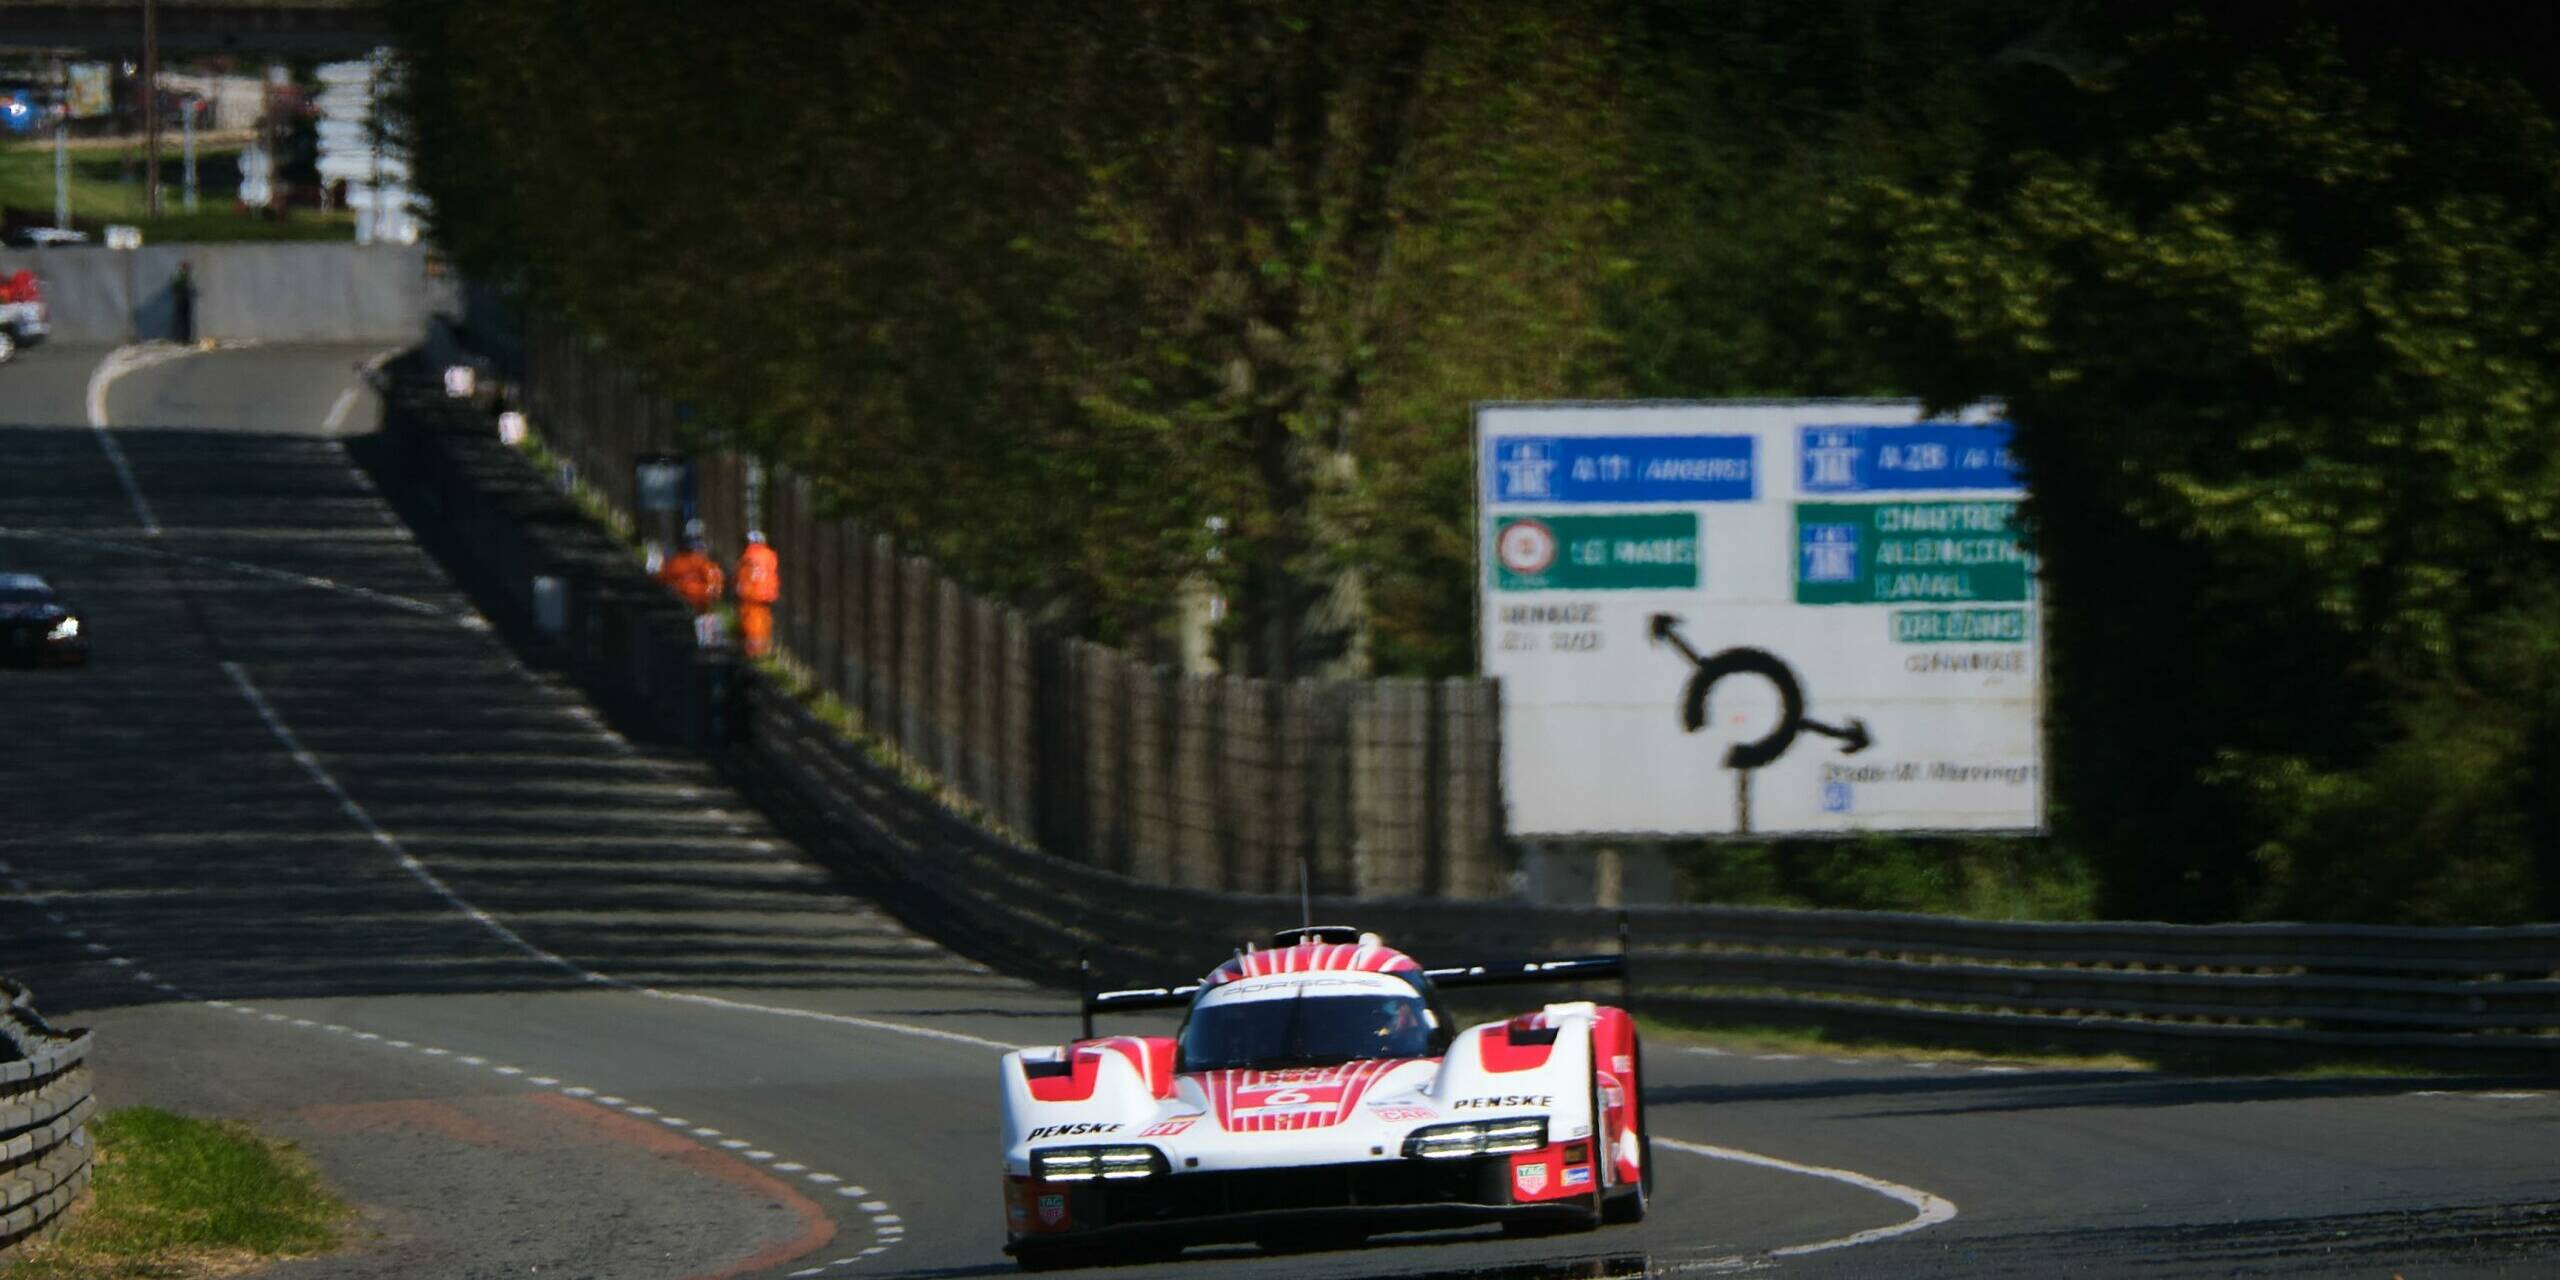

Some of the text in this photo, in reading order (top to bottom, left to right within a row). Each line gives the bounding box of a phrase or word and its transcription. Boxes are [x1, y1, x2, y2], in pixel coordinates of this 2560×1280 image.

[1222, 977, 1385, 996] PORSCHE
[1264, 1088, 1311, 1106] 6
[1453, 1094, 1555, 1110] PENSKE
[1026, 1123, 1125, 1142] PENSKE
